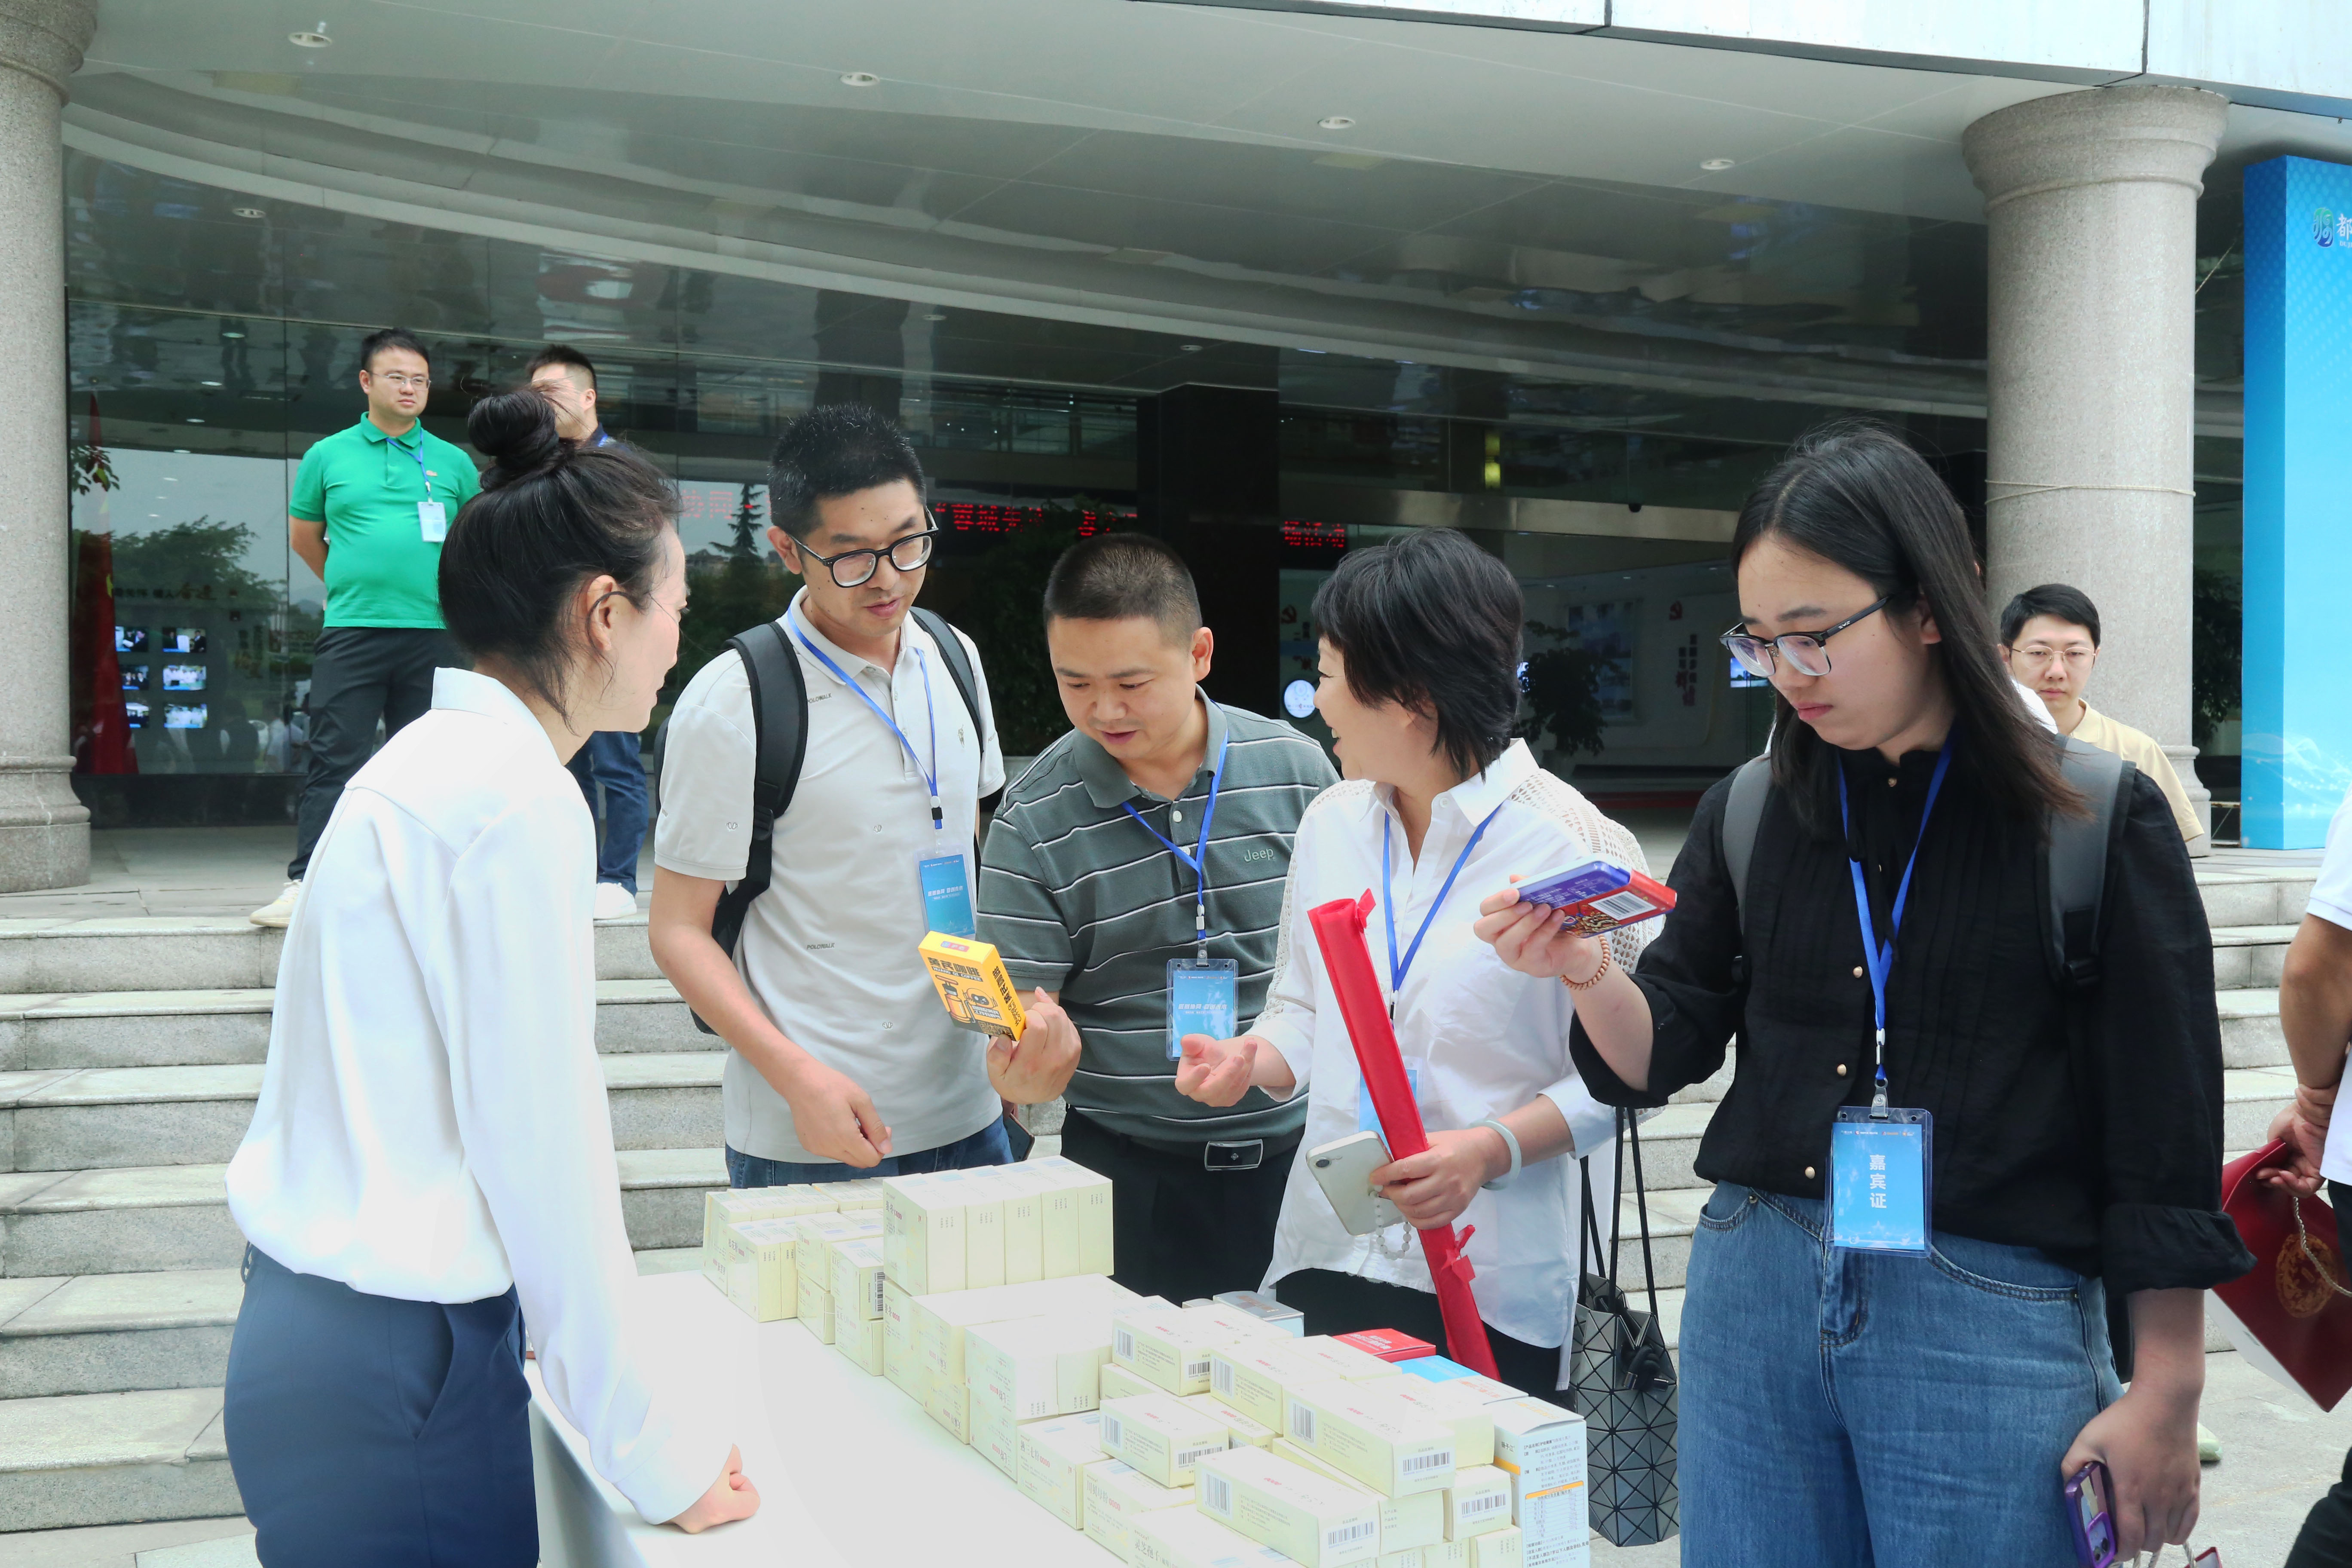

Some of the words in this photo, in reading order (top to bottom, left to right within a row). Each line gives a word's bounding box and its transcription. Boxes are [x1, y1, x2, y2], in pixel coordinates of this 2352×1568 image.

[1243, 845, 1274, 863] Jeep
[961, 974, 982, 982] COFFEE
[1869, 1154, 1887, 1209] 嘉宾证
